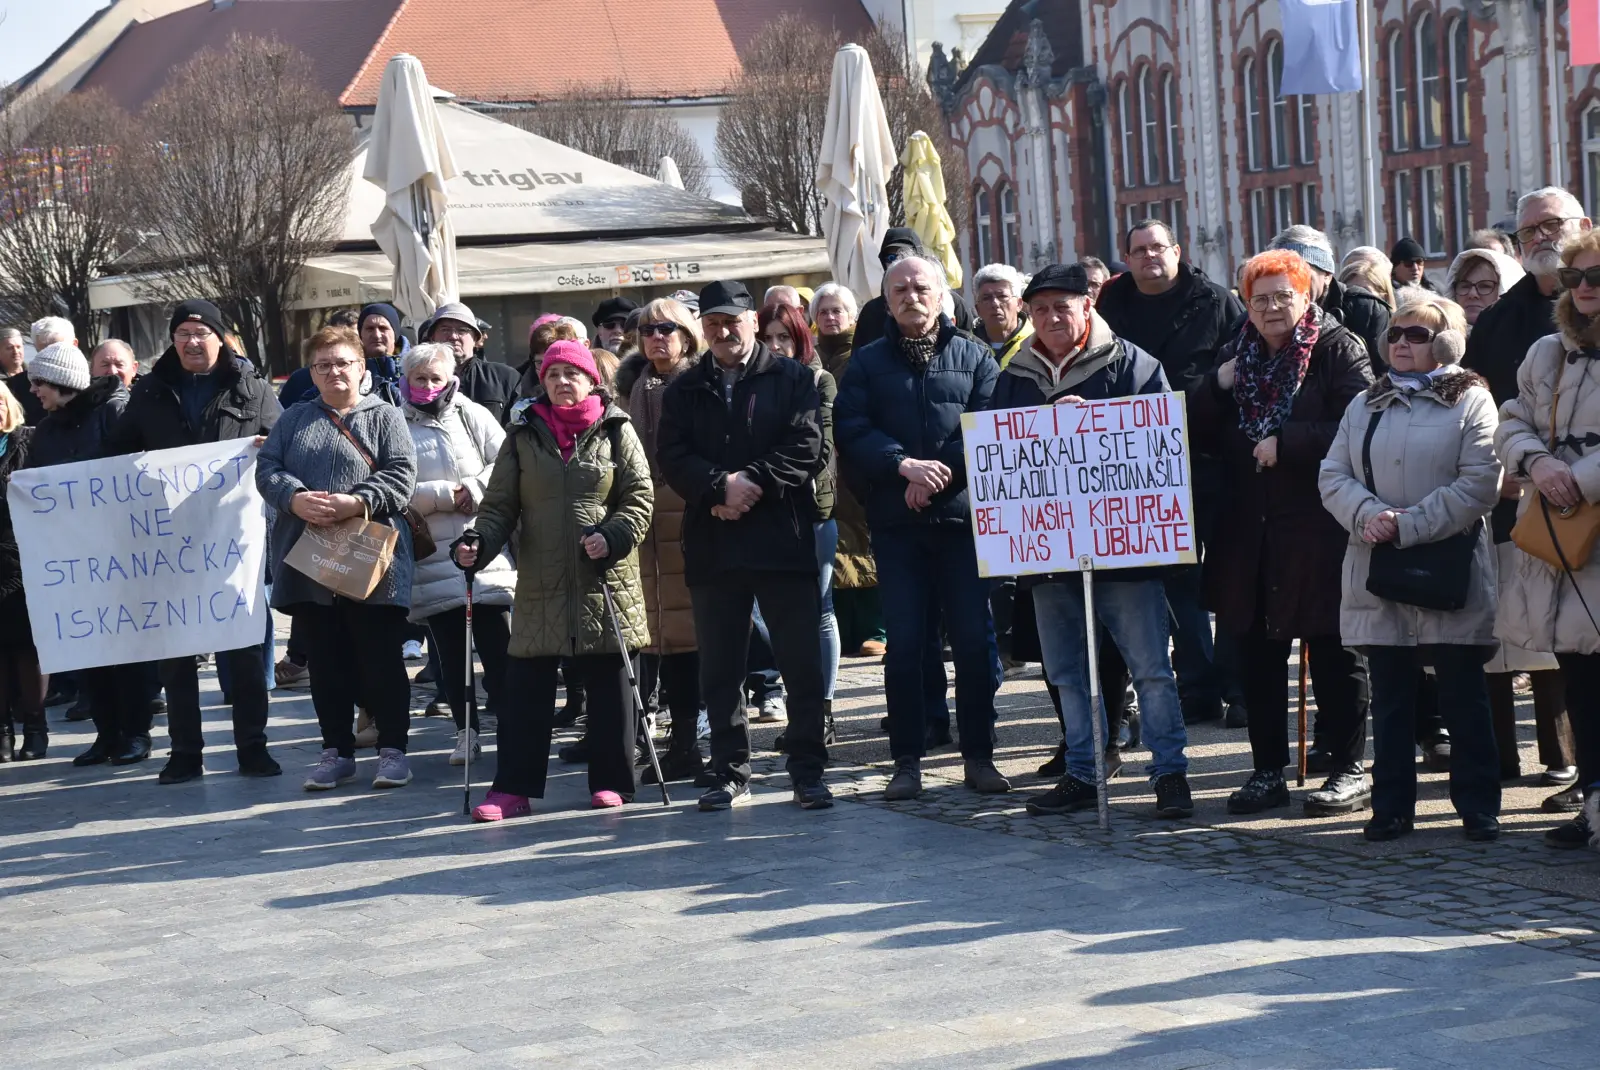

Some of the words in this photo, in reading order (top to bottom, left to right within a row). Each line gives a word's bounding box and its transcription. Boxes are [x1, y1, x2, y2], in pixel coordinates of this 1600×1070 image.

[461, 168, 583, 190] triglav
[487, 200, 560, 208] OSIGURANJE
[587, 272, 606, 285] bar
[687, 263, 700, 274] 3
[993, 409, 1039, 441] HDZ
[1052, 404, 1059, 436] I
[1075, 393, 1169, 434] ŽETONI
[1099, 431, 1138, 462] STE
[31, 455, 249, 514] STRUČNOST
[974, 466, 1058, 502] UNAZADILI
[1064, 464, 1070, 496] I
[130, 507, 174, 538] NE
[975, 506, 1009, 536] BEZ
[1022, 499, 1075, 533] NAŠIH
[1089, 493, 1184, 527] KIRURGA
[43, 535, 244, 587] STRANAČKA
[1009, 533, 1052, 563] NAS
[1067, 527, 1075, 559] I
[1093, 522, 1190, 557] UBIJATE
[54, 587, 250, 641] ISKAZNICA
